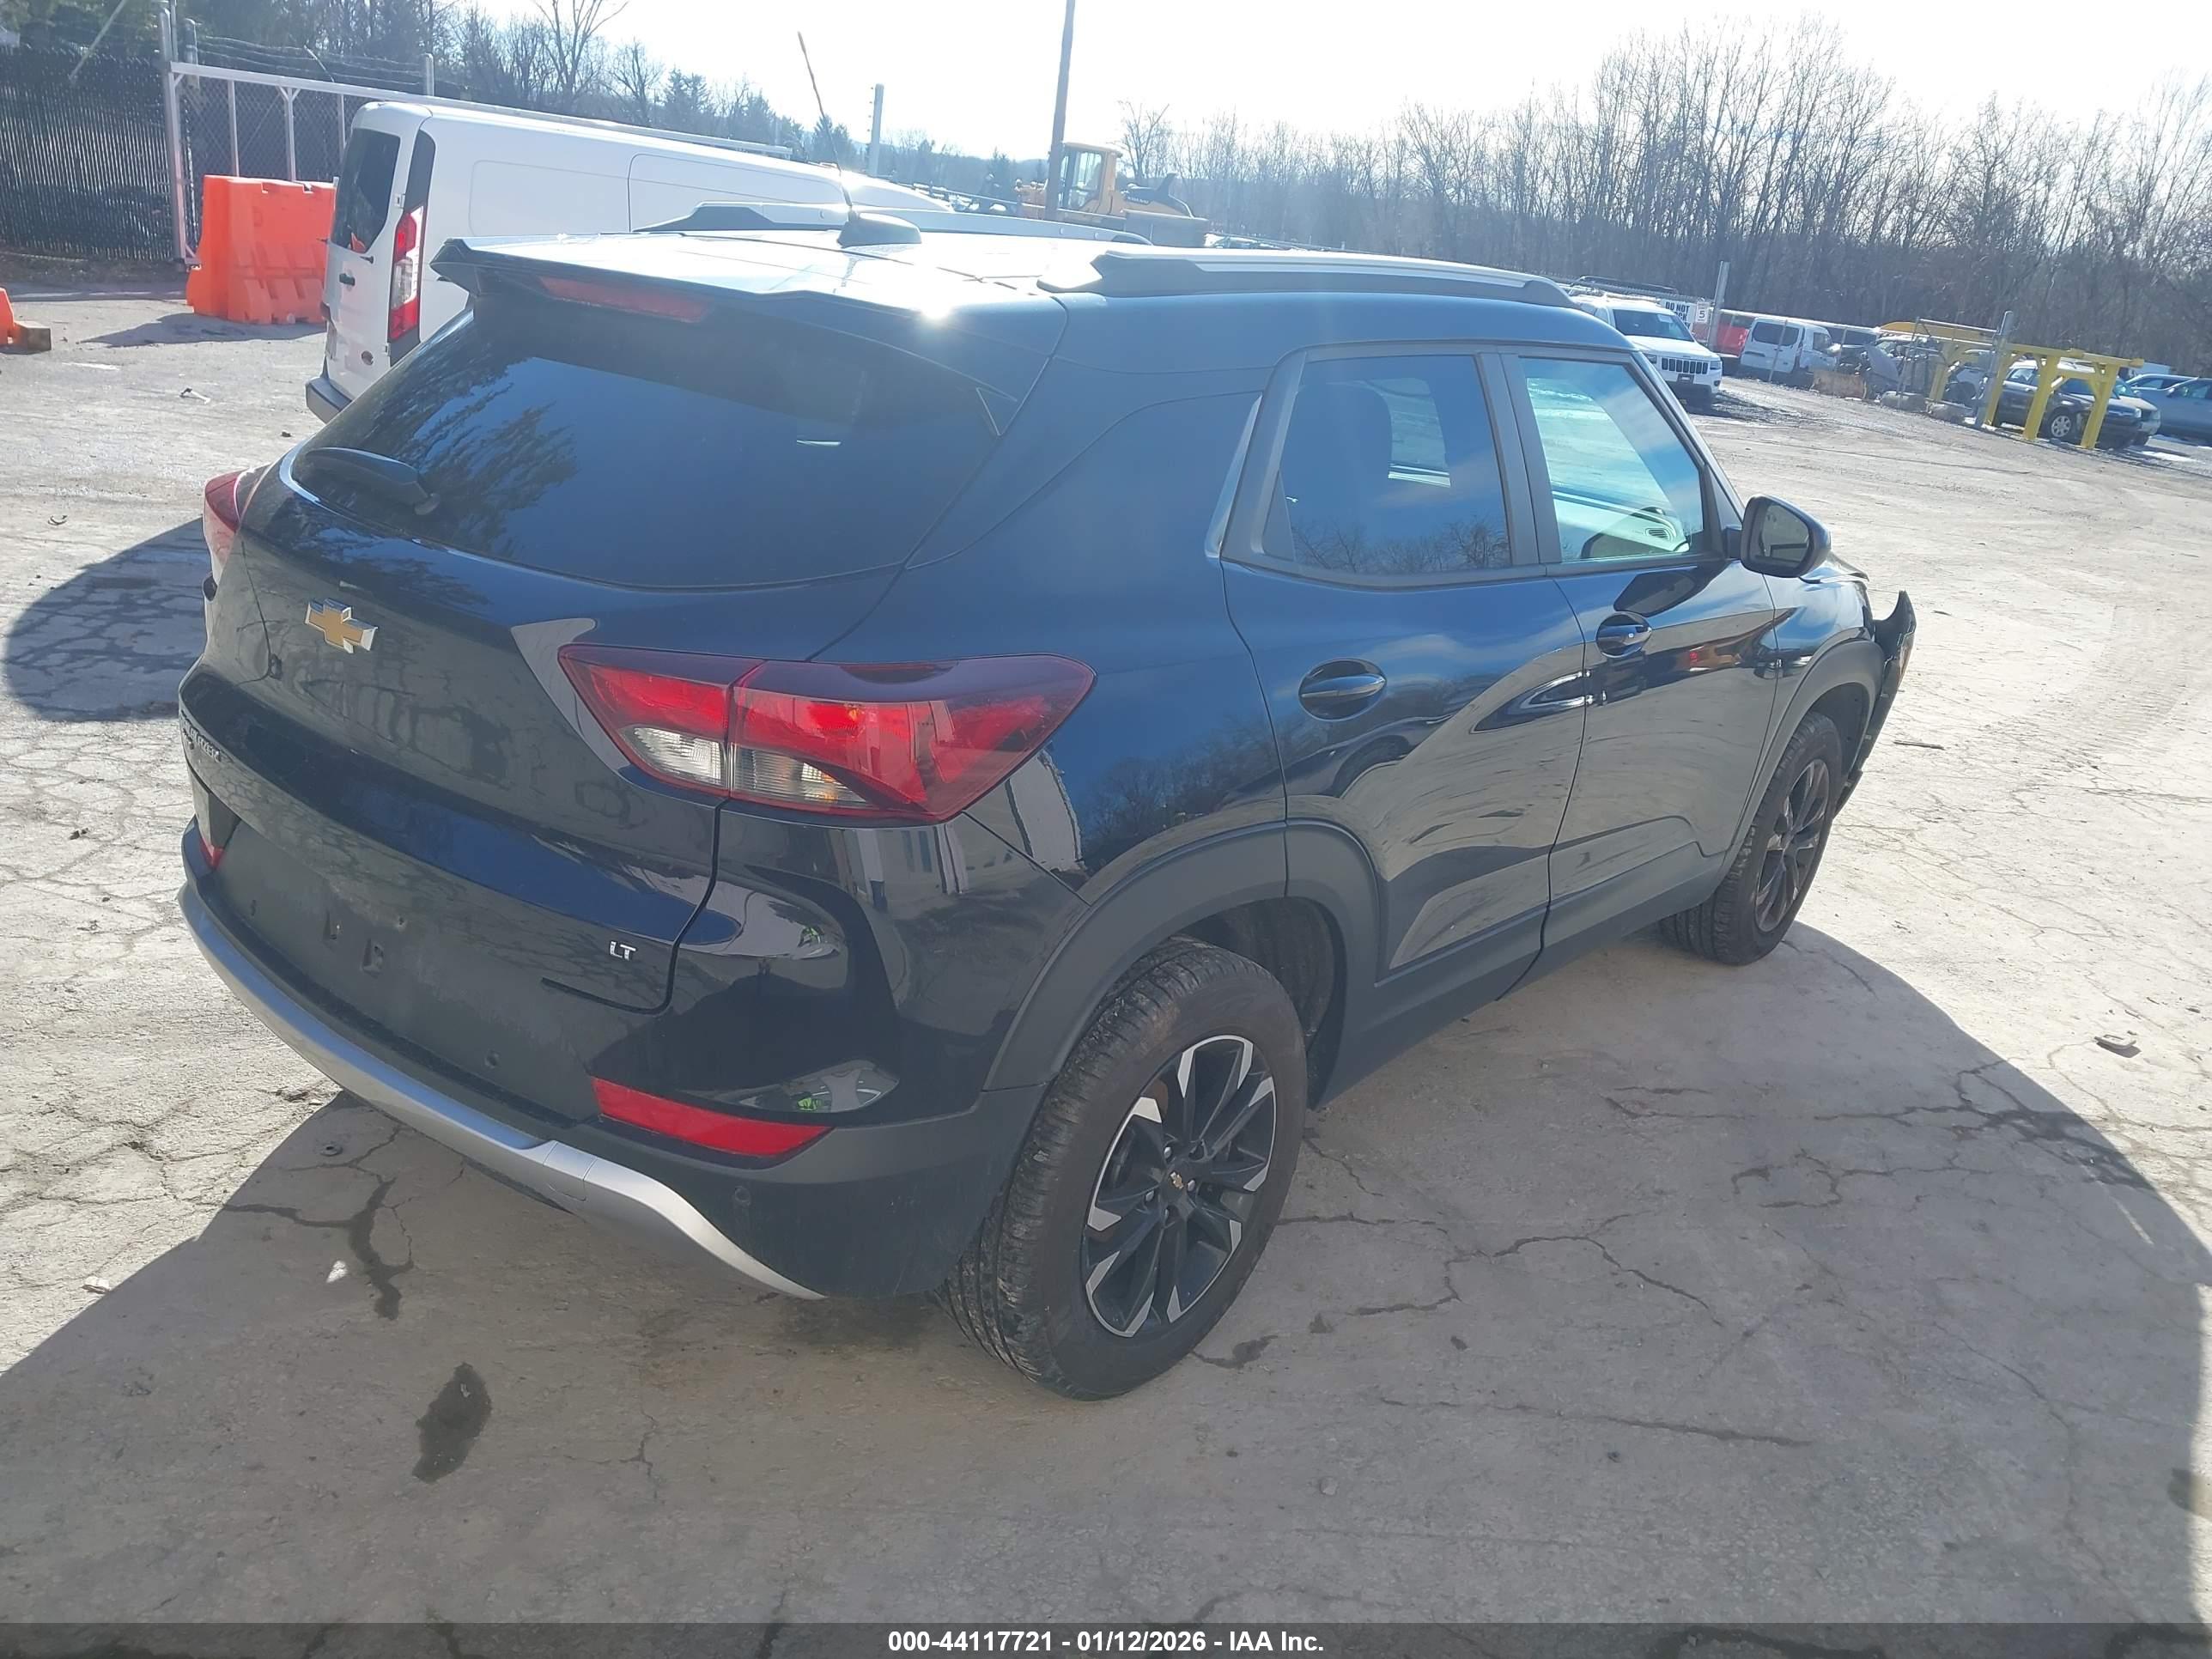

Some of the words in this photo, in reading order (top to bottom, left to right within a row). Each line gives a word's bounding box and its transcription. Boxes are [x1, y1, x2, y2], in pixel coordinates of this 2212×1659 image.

[1666, 301, 1674, 310] DO
[1676, 304, 1690, 314] NOT
[1699, 310, 1705, 319] 5
[610, 940, 637, 962] LT
